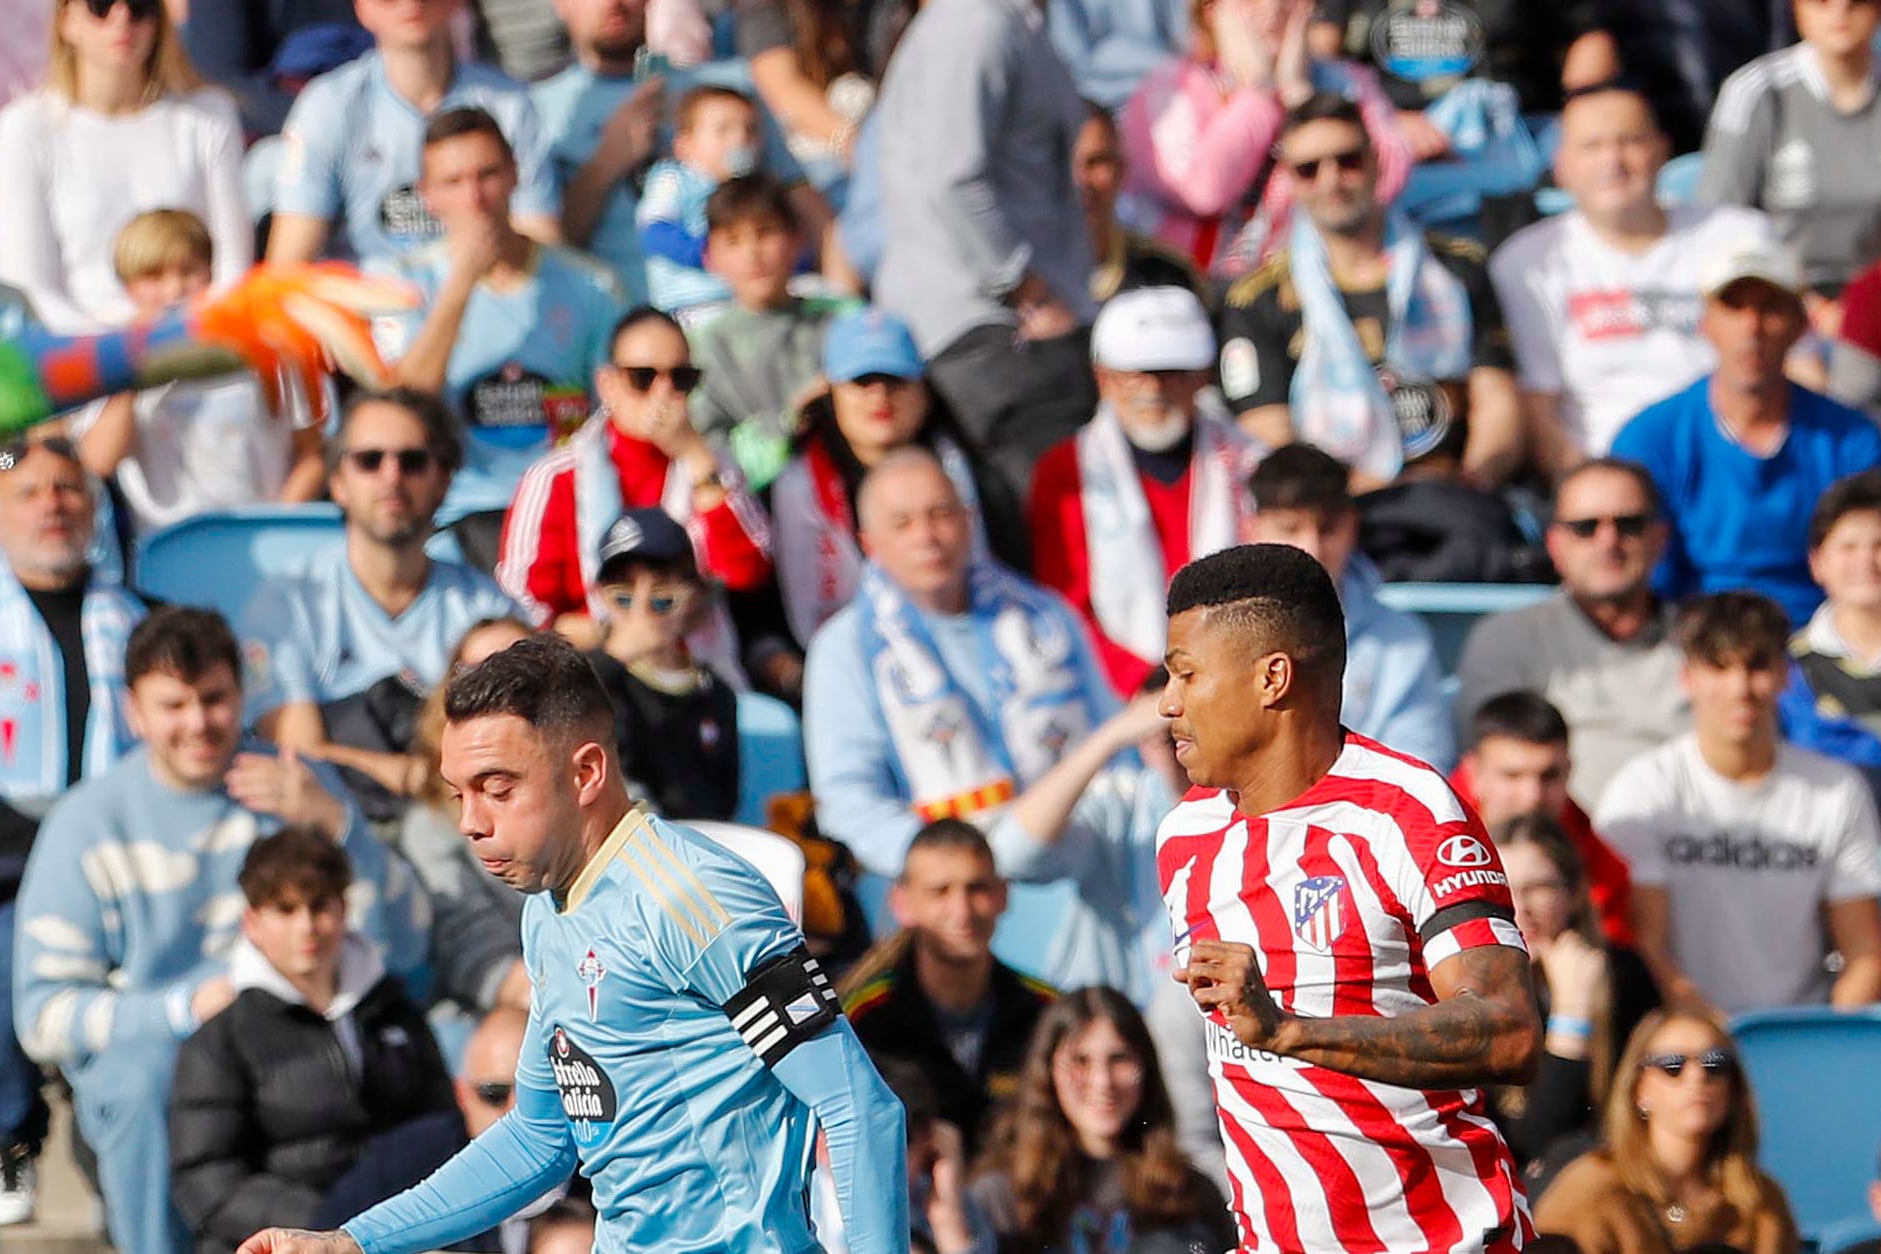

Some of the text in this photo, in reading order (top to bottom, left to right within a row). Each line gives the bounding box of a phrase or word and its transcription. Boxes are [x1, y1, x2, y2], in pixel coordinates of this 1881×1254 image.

[1433, 869, 1509, 899] HYUNDA
[550, 1056, 600, 1086] strella
[559, 1086, 603, 1116] alicia
